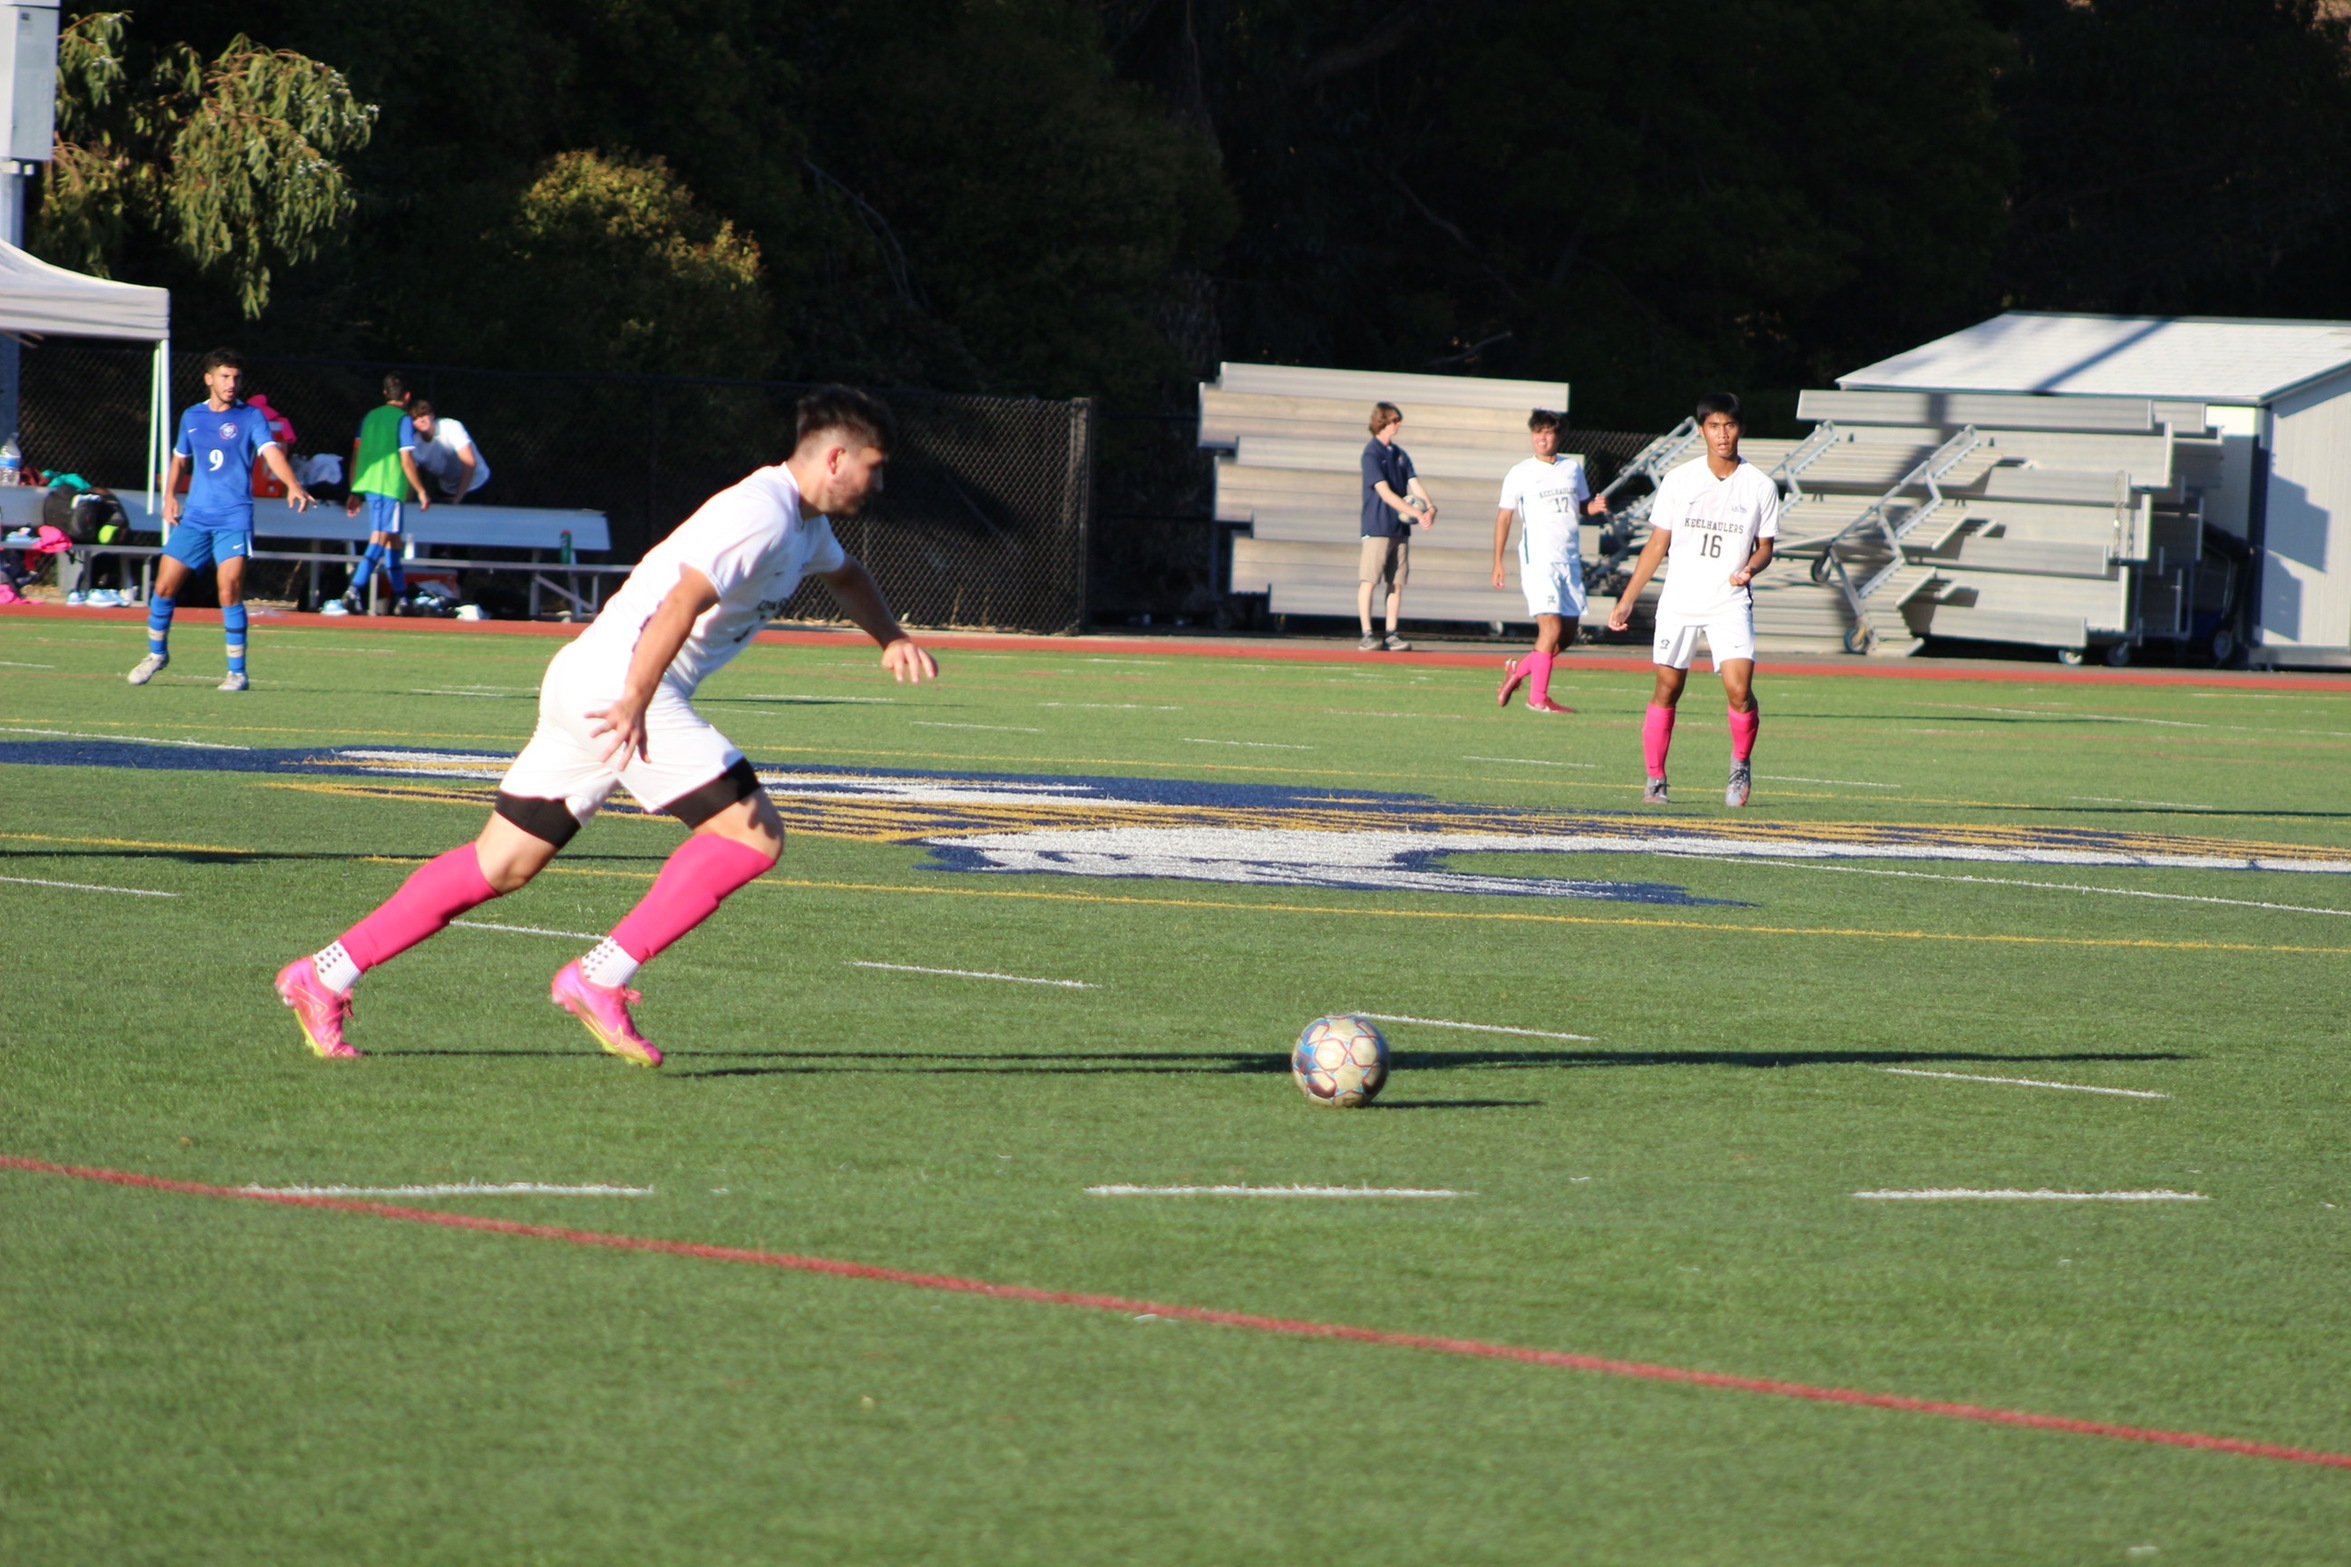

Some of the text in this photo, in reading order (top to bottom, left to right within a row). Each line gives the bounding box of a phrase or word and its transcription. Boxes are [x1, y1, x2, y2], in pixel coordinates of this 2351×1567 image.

[208, 448, 224, 471] 9
[1555, 497, 1569, 513] 17
[1684, 517, 1744, 535] KEELHAULERS
[1700, 533, 1723, 559] 16
